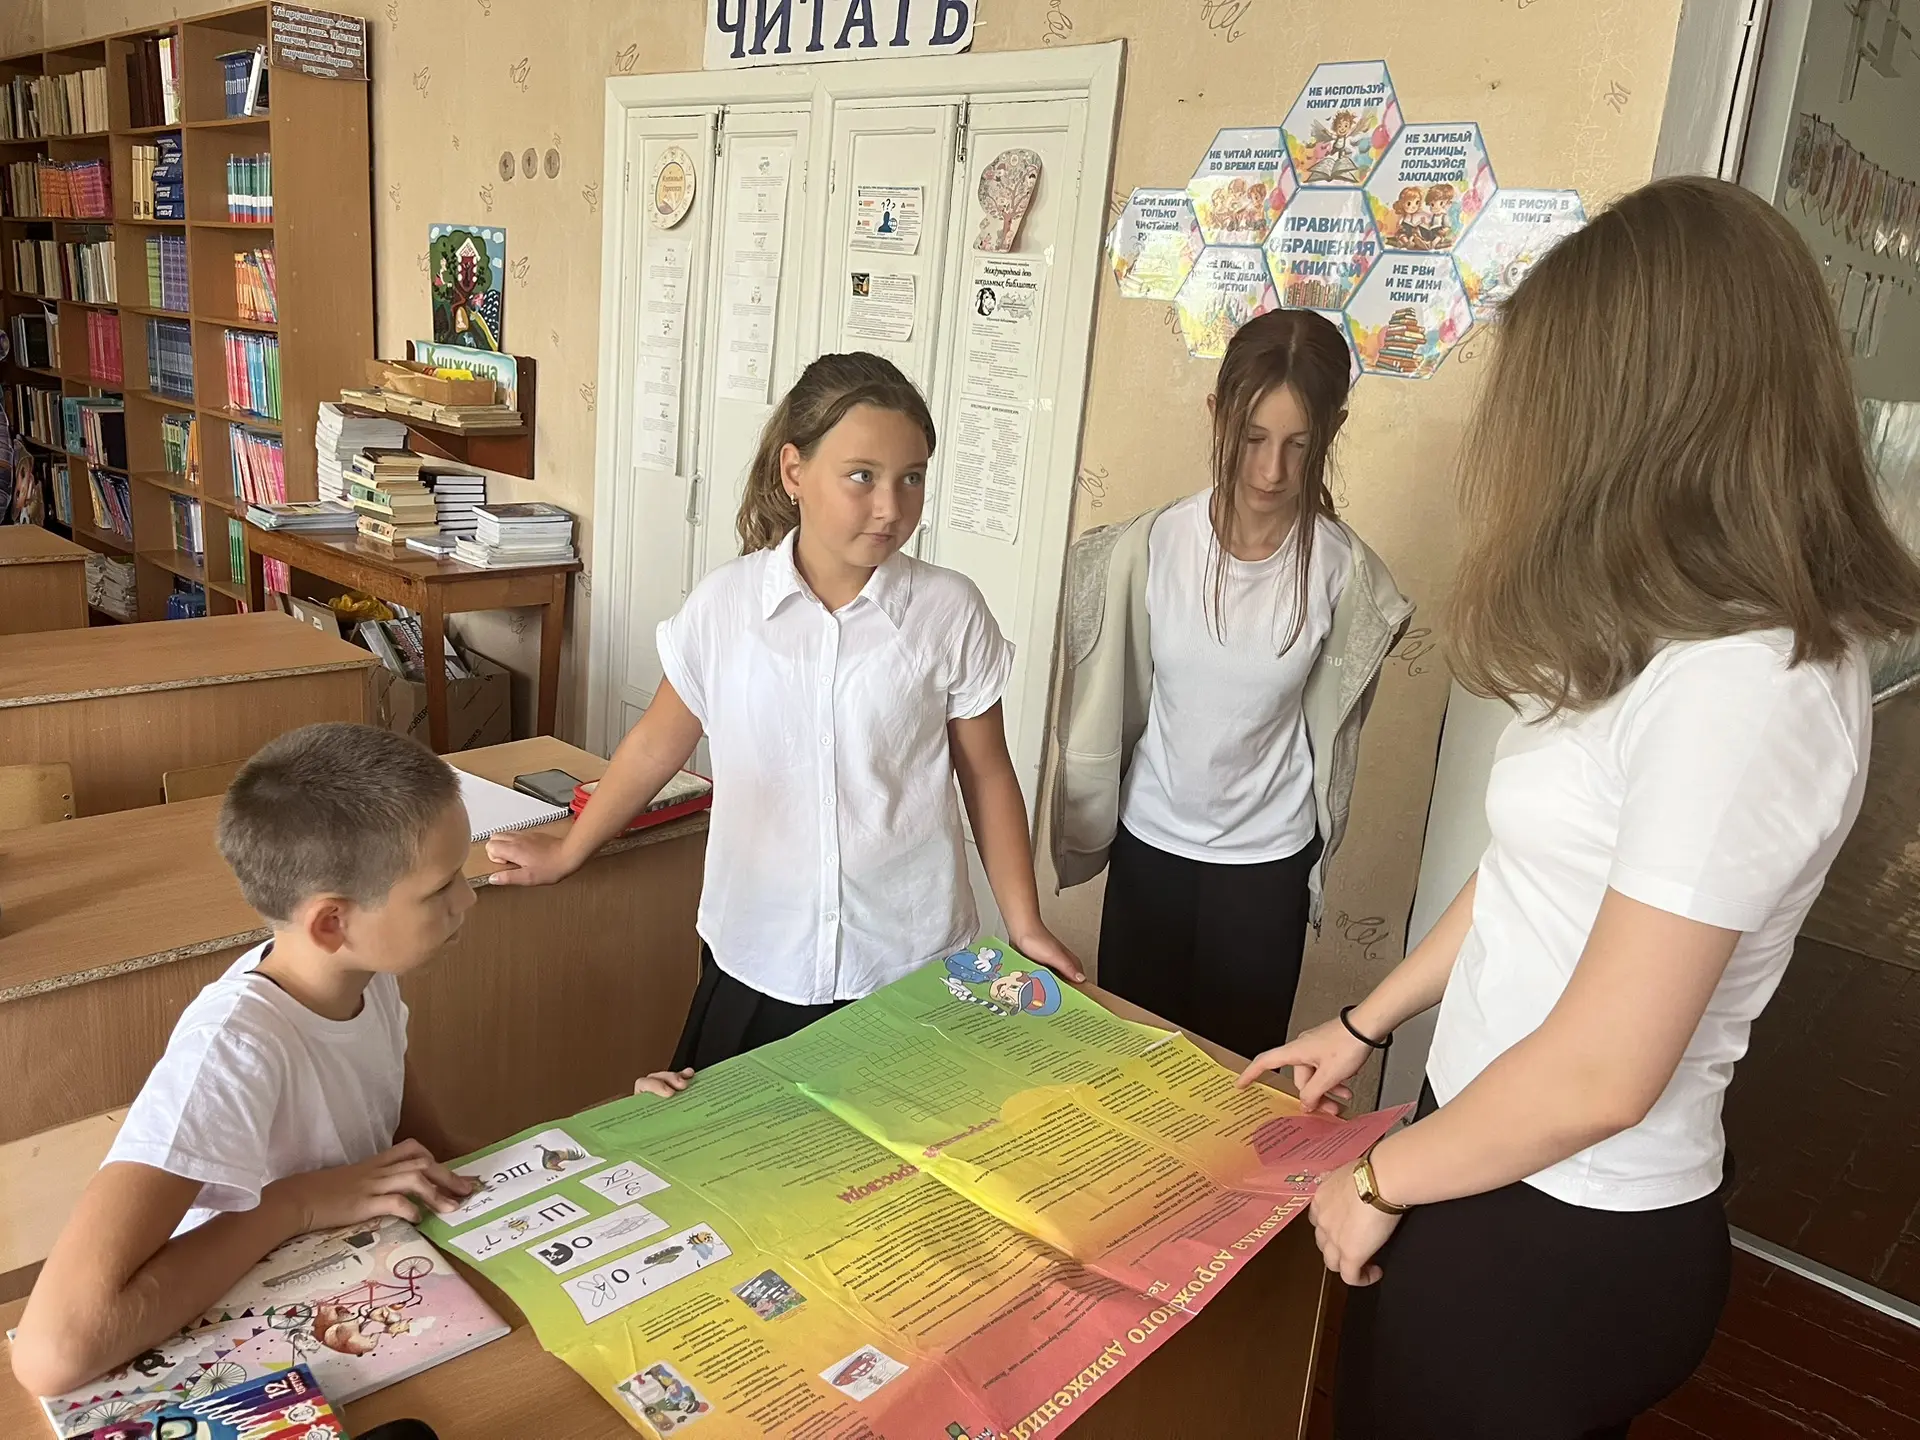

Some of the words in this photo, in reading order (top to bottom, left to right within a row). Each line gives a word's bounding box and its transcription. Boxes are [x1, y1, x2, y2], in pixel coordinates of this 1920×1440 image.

[1309, 85, 1322, 96] НЕ
[1324, 82, 1385, 96] ИСПОЛЬЗУЙ
[1306, 96, 1337, 108] КНИГУ
[1339, 96, 1361, 109] ДЛЯ
[1363, 95, 1383, 107] ИГР
[1405, 133, 1420, 145] НЕ
[1422, 131, 1472, 144] ЗАГИБАЙ
[1209, 151, 1222, 159] НЕ
[1224, 149, 1252, 159] ЧИТАЙ
[1254, 150, 1282, 159] КНИГУ
[1405, 146, 1467, 159] СТРАНИЦЫ,
[1210, 162, 1223, 170] ВО
[1225, 162, 1255, 170] ВРЕМЯ
[1258, 162, 1278, 170] ЕДЫ
[1400, 157, 1466, 170] ПОЛЬЗУЙСЯ
[1397, 168, 1463, 182] ЗАКЛАДКОЙ
[1158, 197, 1189, 206] КНИГИ
[1500, 198, 1511, 209] НЕ
[1513, 196, 1557, 211] РИСУЙ
[1560, 199, 1569, 210] В
[1141, 210, 1177, 218] ТОЛЬКО
[1512, 211, 1552, 224] КНИГЕ
[1284, 217, 1364, 233] ПРАВИЛА
[1269, 238, 1375, 257] ОБРАЩЕНИЯ
[1248, 261, 1255, 269] В
[1276, 260, 1286, 274] С
[1291, 260, 1361, 277] КНИГОЙ
[1392, 264, 1409, 276] НЕ
[1411, 264, 1435, 276] РВИ
[1224, 272, 1236, 280] НЕ
[1237, 271, 1269, 282] ДЕЛАЙ
[1385, 278, 1393, 289] И
[1396, 278, 1412, 289] НЕ
[1415, 278, 1442, 291] МНИ
[1390, 291, 1429, 303] КНИГИ
[492, 1161, 532, 1184] ше
[538, 1202, 577, 1222] Ш
[1127, 1248, 1235, 1345] дорожного
[265, 1378, 292, 1399] 12
[286, 1371, 306, 1396] ЦВЕТОВ
[1009, 1339, 1128, 1440] движения
